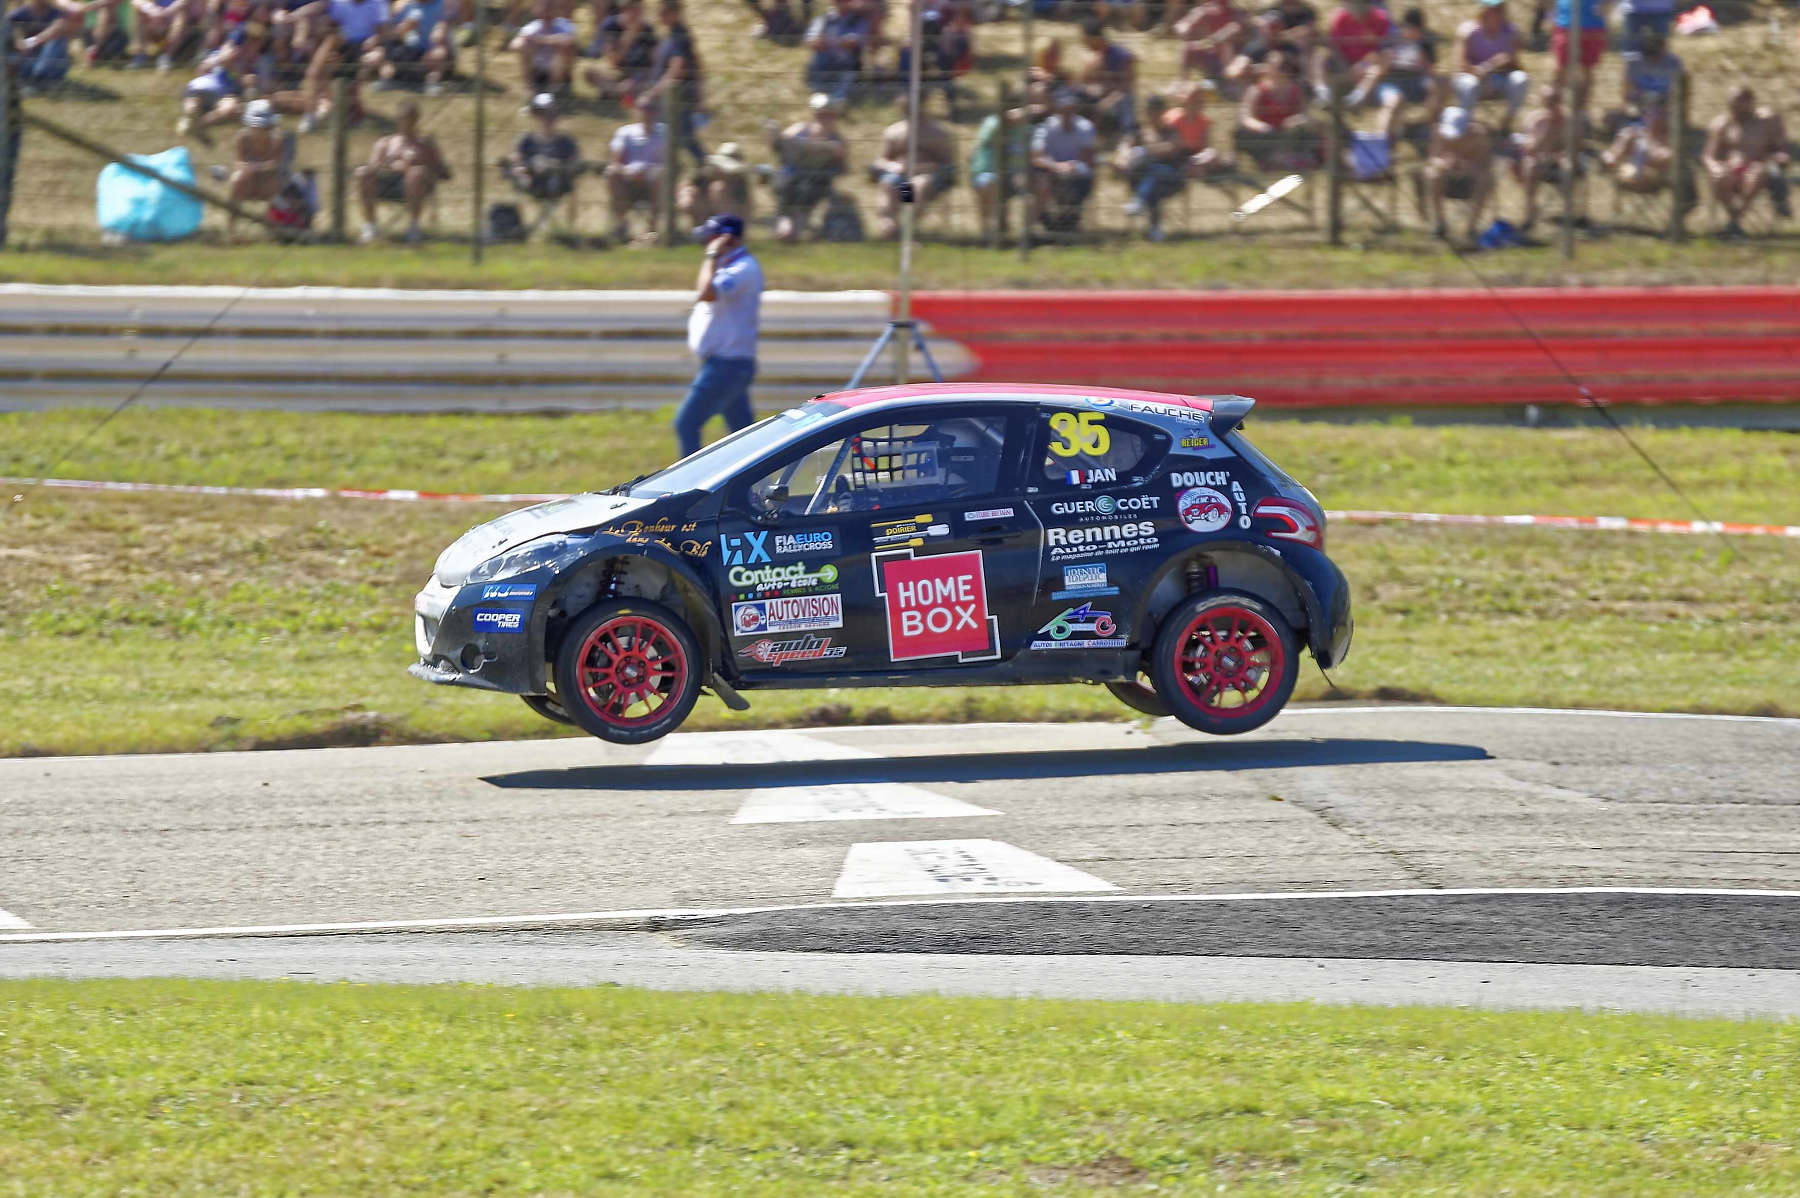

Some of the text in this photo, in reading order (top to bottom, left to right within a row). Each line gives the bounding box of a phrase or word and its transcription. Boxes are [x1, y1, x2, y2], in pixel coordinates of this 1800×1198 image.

[1128, 403, 1204, 420] FAUCHE
[1049, 412, 1111, 457] 35
[1086, 468, 1117, 483] JAN
[1170, 472, 1230, 487] DOUCH'
[1232, 481, 1252, 529] AUTO
[1080, 513, 1138, 521] AUTOMOBILES
[681, 521, 697, 532] est
[1047, 521, 1155, 546] Rennes
[775, 541, 834, 554] RALLYCROSS
[1050, 537, 1159, 555] Auto-Moto
[728, 561, 806, 588] Contact
[898, 574, 976, 608] HOME
[768, 595, 840, 621] AUTOVISION
[476, 613, 521, 622] COOPER
[497, 621, 520, 629] TIRES
[901, 604, 978, 637] BOX
